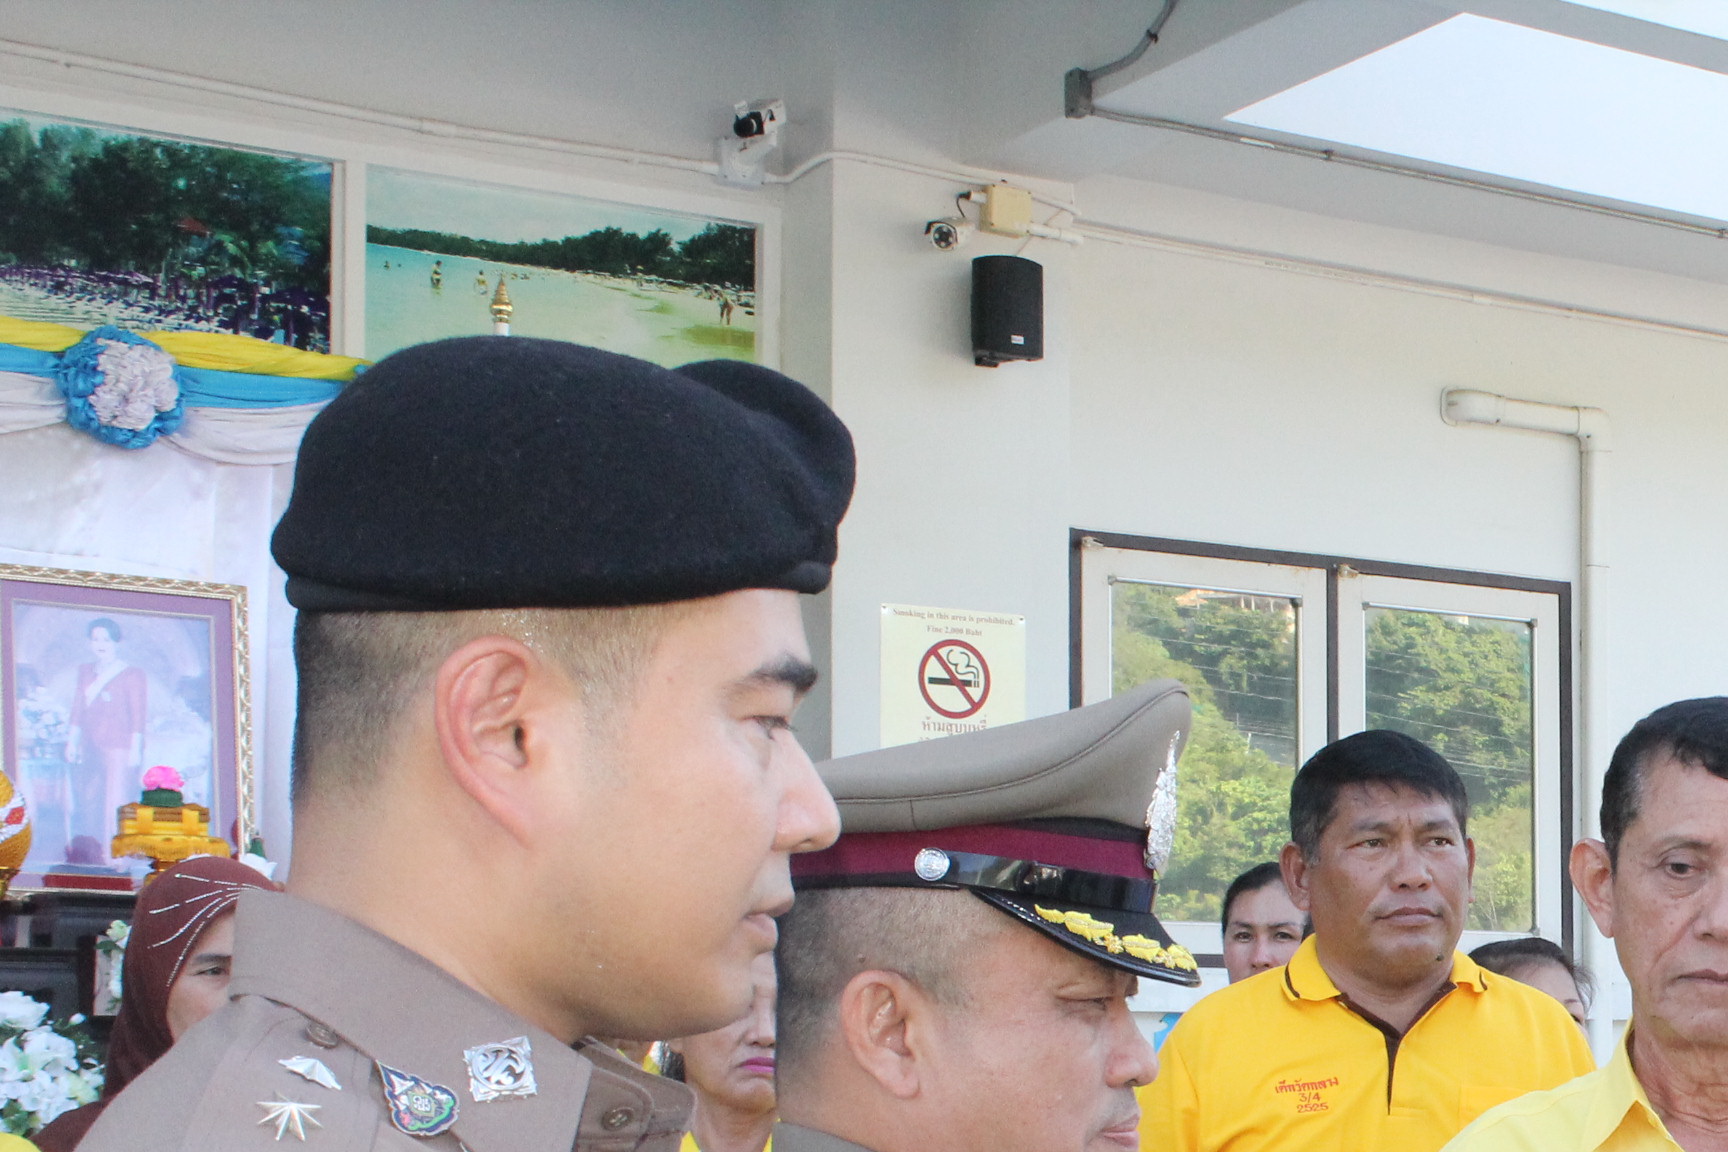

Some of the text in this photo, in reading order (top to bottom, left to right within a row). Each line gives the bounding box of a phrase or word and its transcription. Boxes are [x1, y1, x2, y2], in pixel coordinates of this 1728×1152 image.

[951, 614, 967, 622] area
[927, 625, 942, 633] Fine
[965, 627, 982, 637] Baht
[1299, 1092, 1321, 1103] 3/4
[1297, 1102, 1328, 1113] 2525
